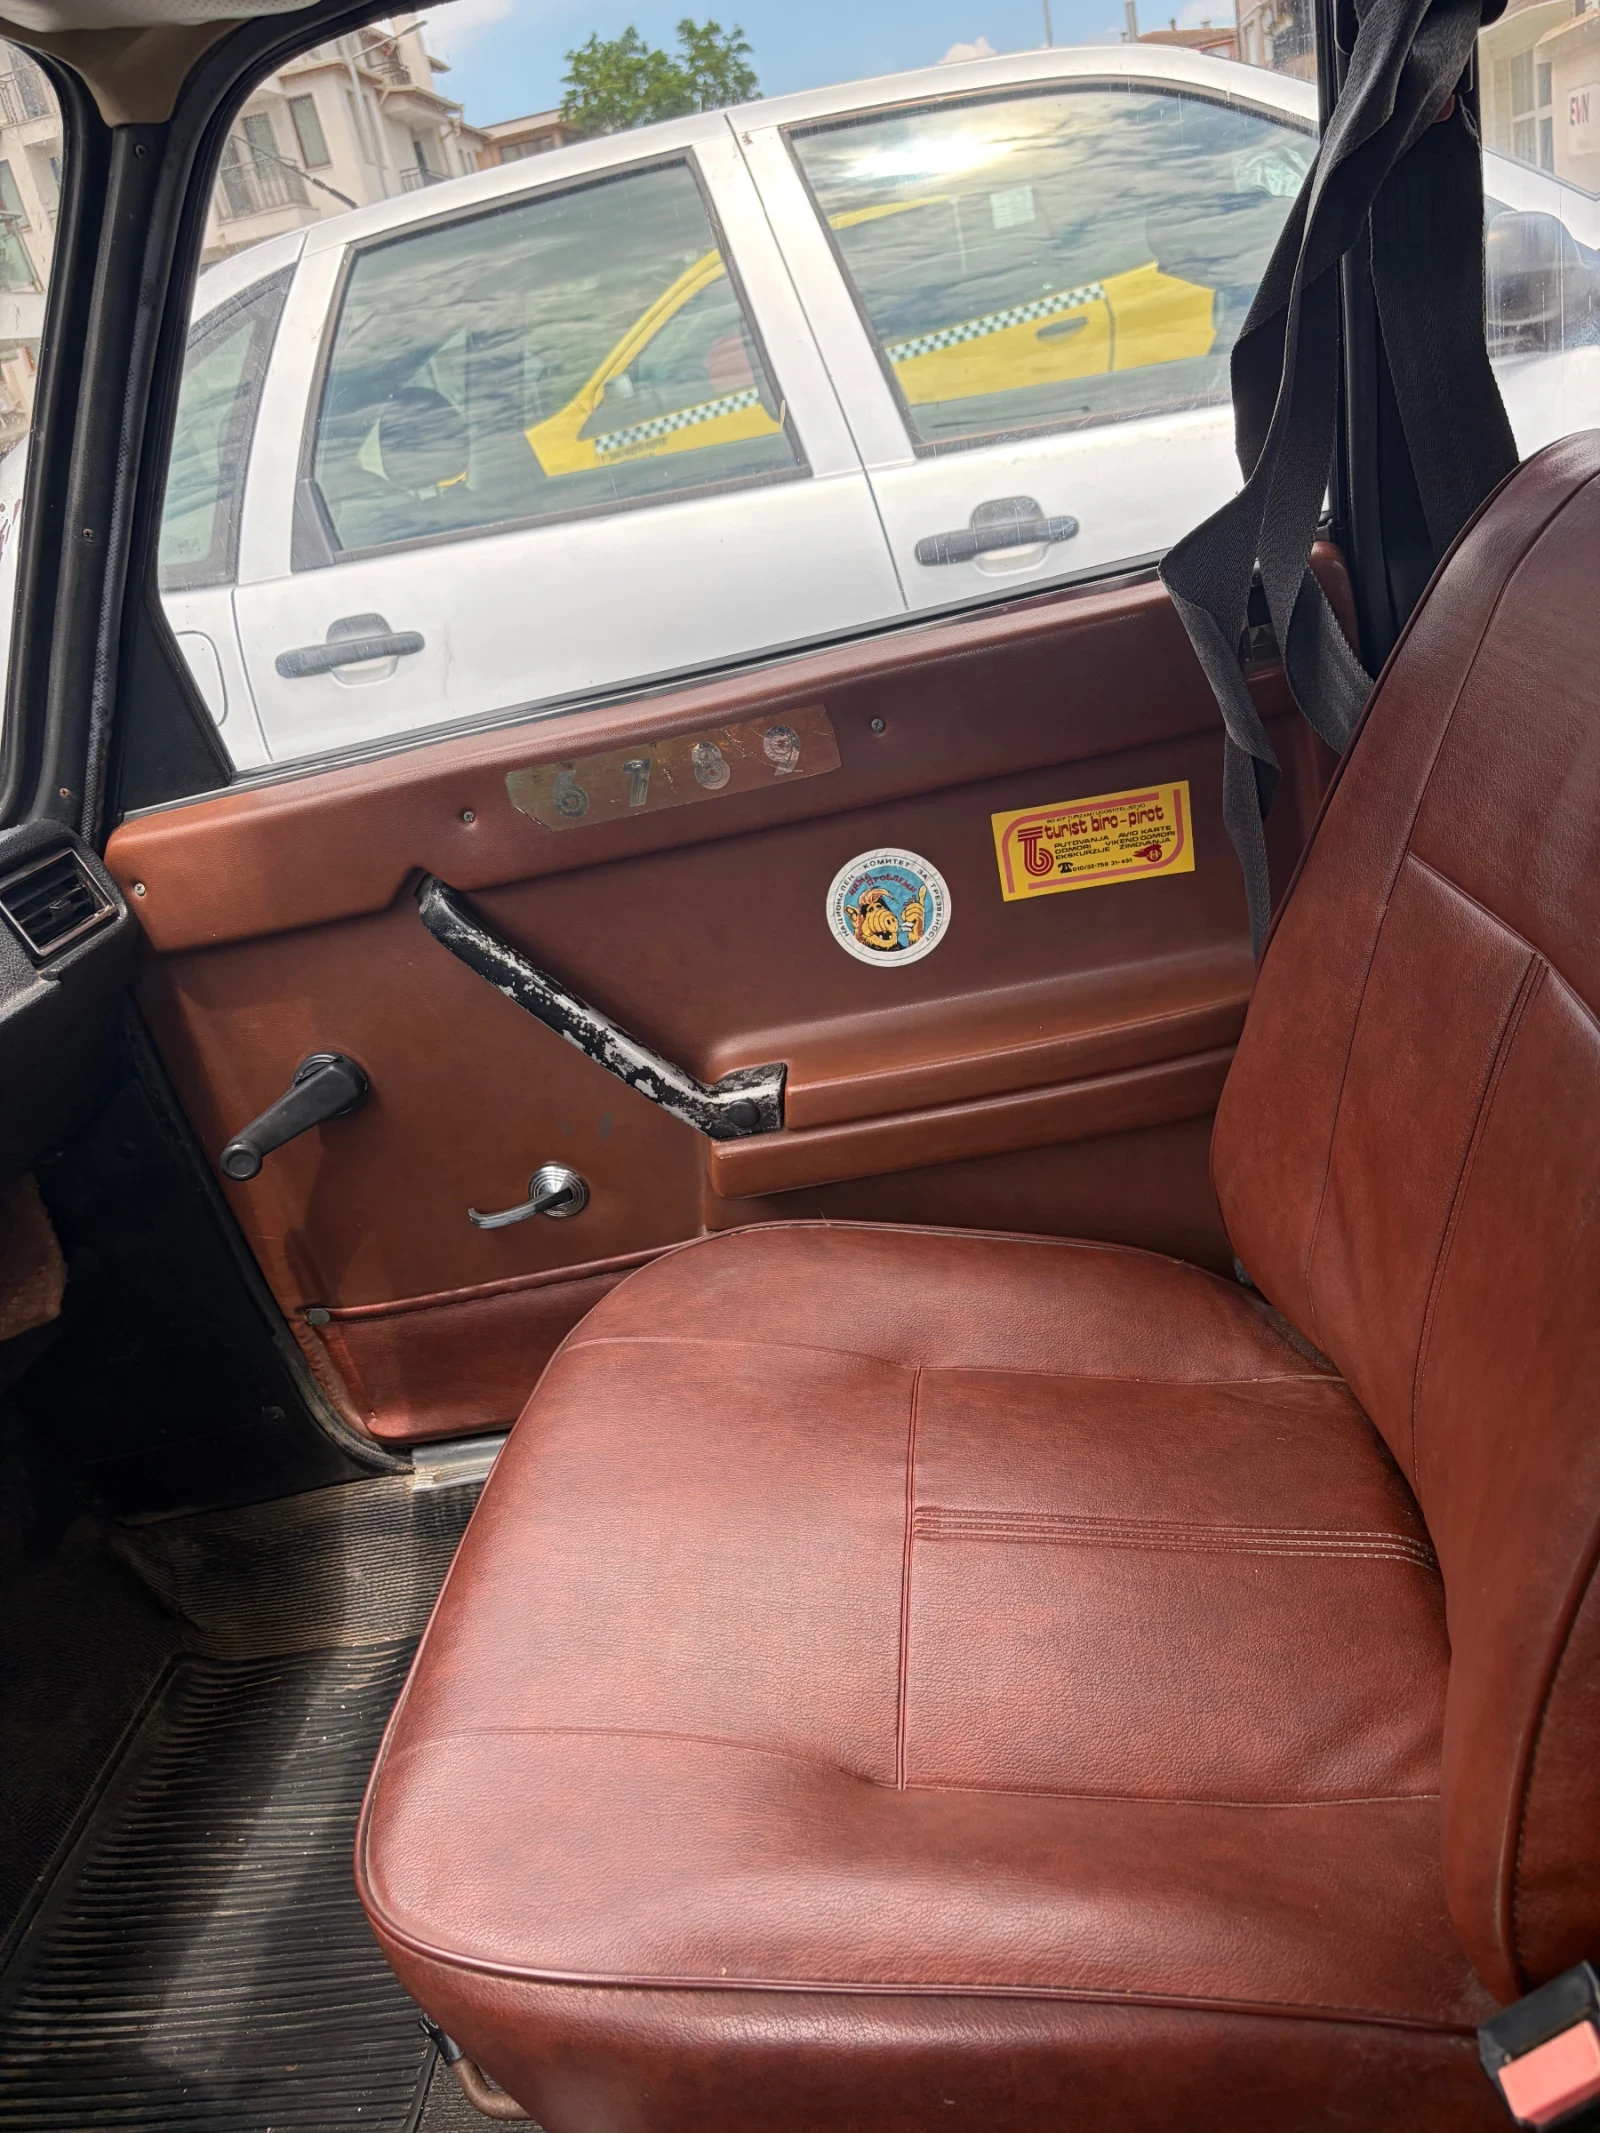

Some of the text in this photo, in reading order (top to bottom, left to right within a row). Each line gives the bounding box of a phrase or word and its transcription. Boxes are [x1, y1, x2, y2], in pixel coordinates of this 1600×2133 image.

[1569, 92, 1591, 126] EVN
[691, 741, 731, 790] 8
[763, 724, 801, 777] 9
[1044, 818, 1088, 840] turist
[1090, 814, 1119, 833] biro
[1128, 805, 1164, 828] pirot
[1104, 830, 1176, 846] VIKEND ODMORI
[1118, 824, 1172, 838] AVIO KARTE
[1054, 835, 1110, 848] PUTOVANJA
[1054, 844, 1092, 854] ODMORI
[1119, 837, 1171, 850] ZIMOVANJA
[1055, 847, 1111, 860] EKSKURZIJE
[866, 873, 917, 893] ПРОБЛЕМИ
[834, 857, 944, 943] НАЦИОНАЛЕН КОМИТЕТ ЗА ТРЕЗВЕНОСТ
